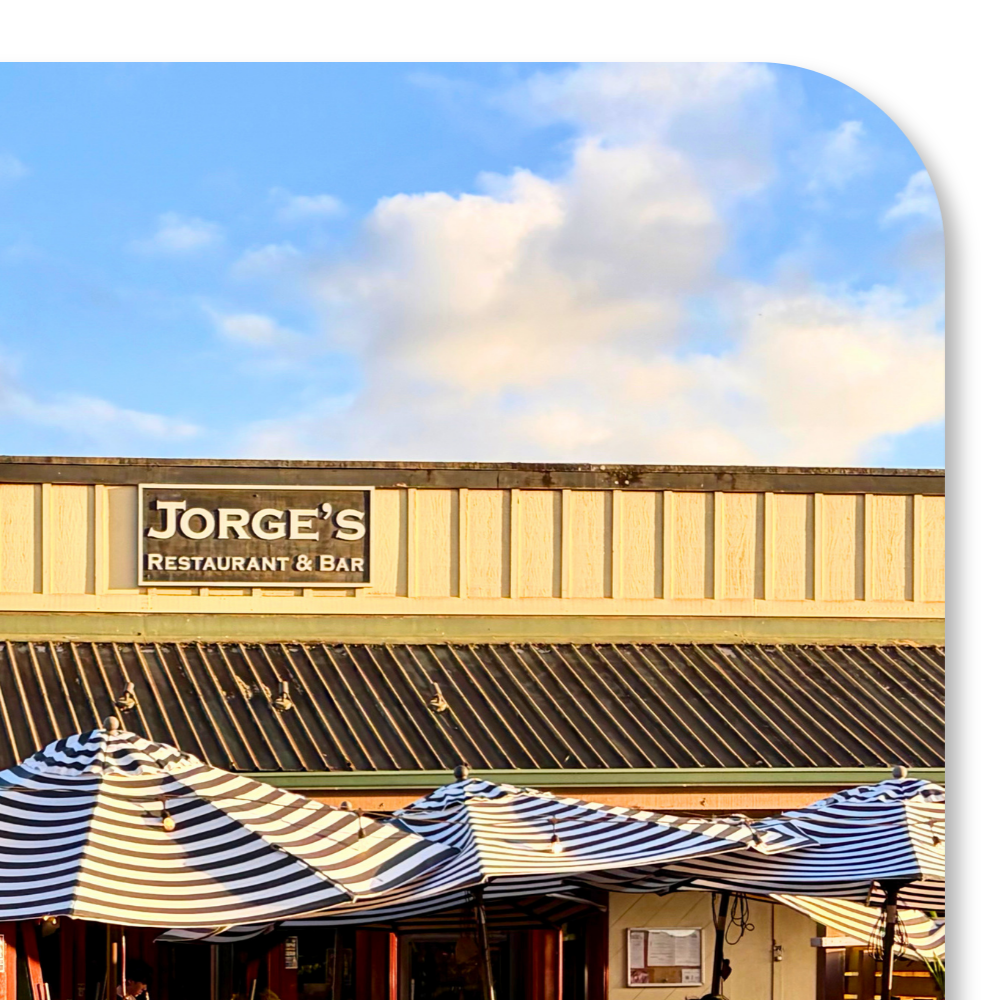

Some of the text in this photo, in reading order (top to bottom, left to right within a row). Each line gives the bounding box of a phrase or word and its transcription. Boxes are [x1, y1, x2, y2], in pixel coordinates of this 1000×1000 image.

[147, 500, 366, 541] JORGE'S
[147, 553, 364, 572] RESTAURANT & BAR
